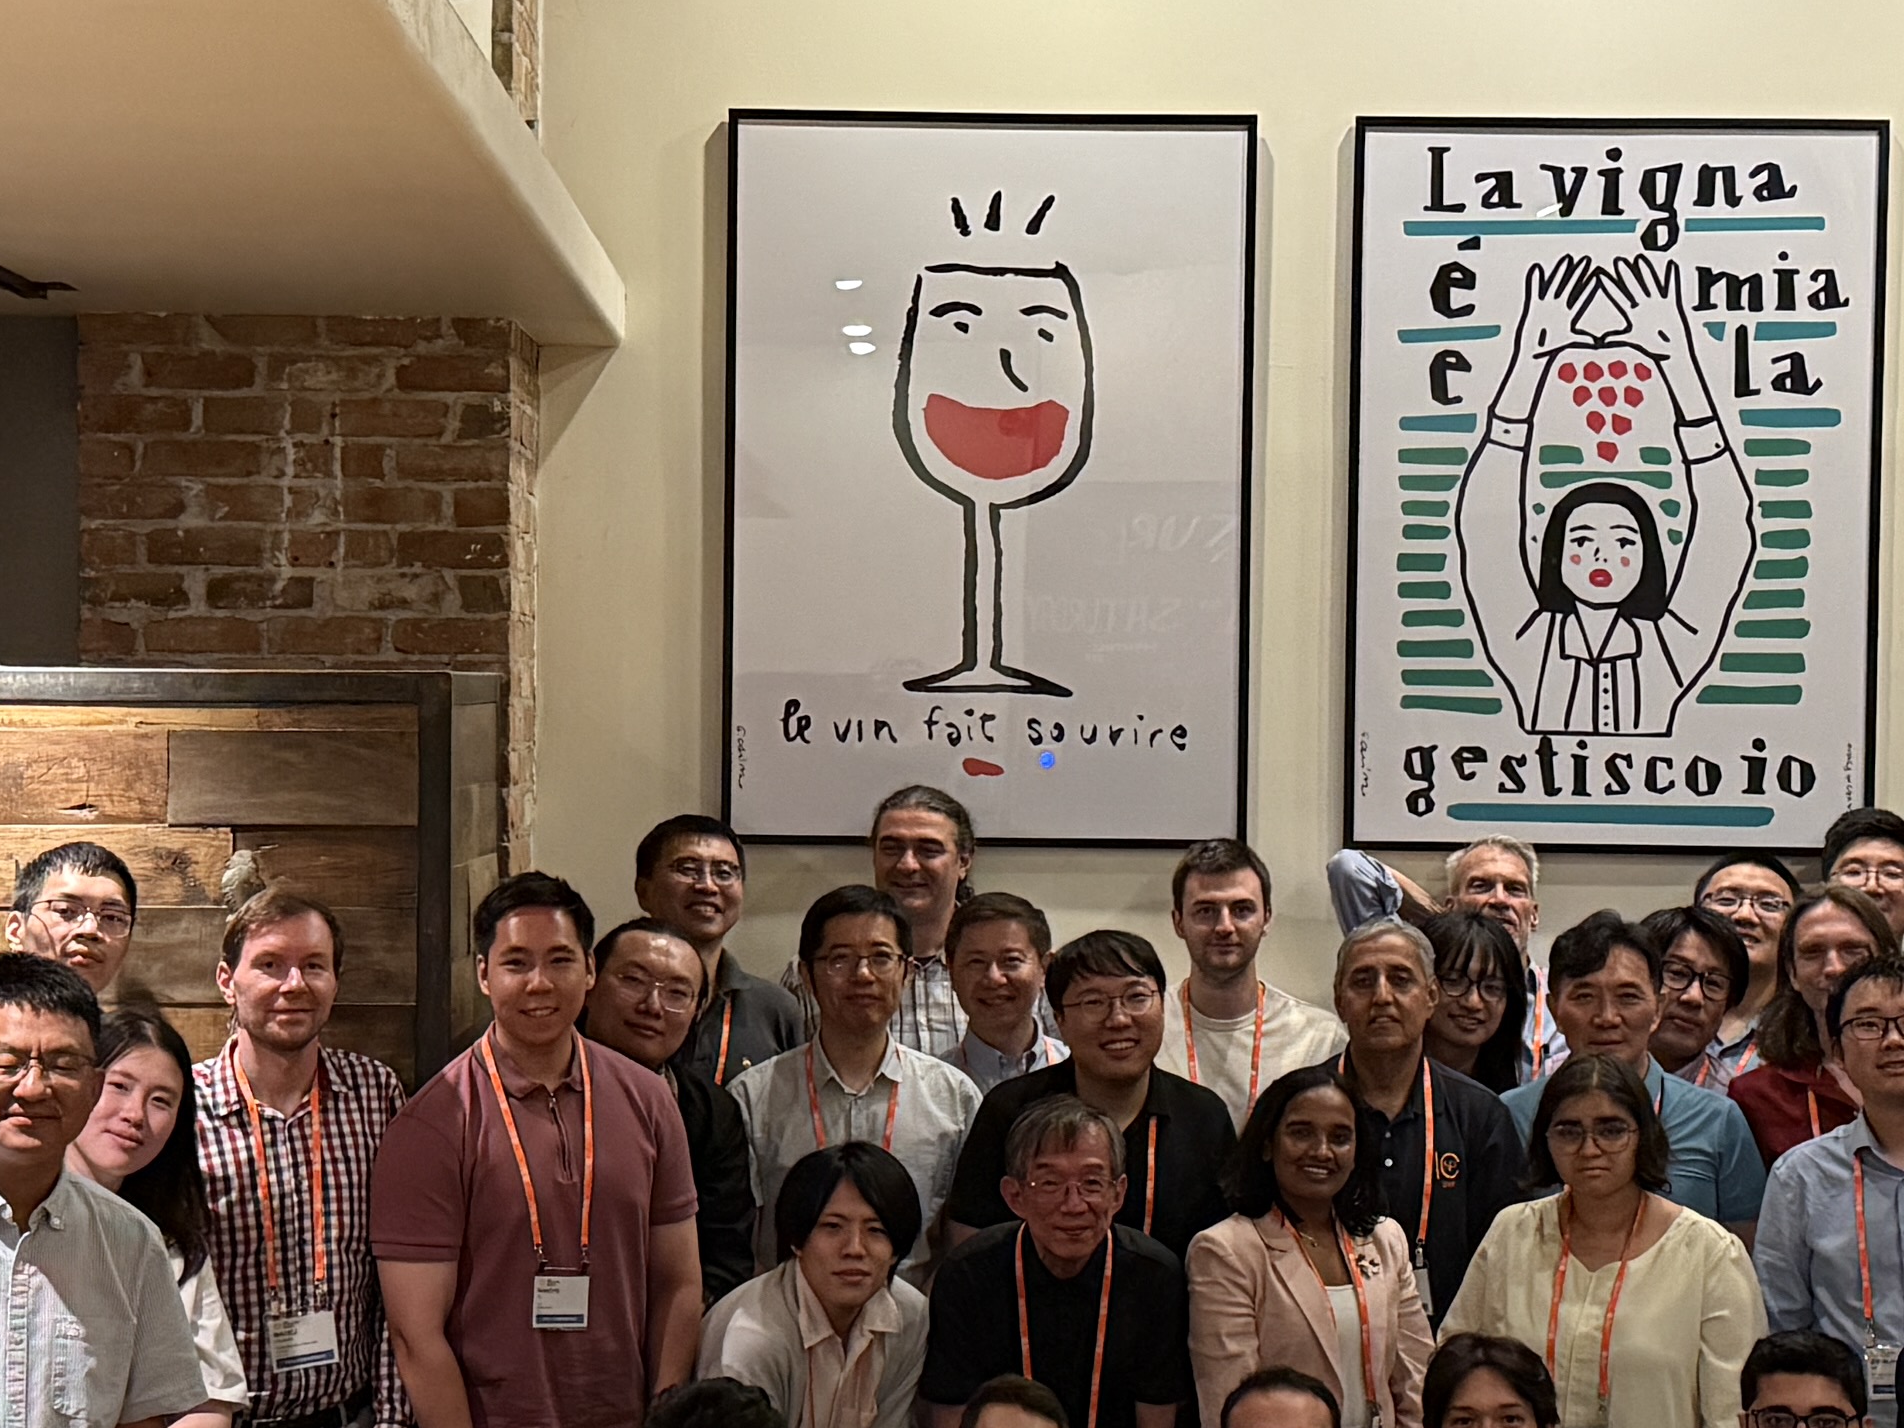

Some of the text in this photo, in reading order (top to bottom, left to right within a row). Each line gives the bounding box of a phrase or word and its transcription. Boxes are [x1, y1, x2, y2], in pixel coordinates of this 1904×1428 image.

[1423, 146, 1798, 254] La vigna
[1691, 251, 1850, 313] mia
[1429, 324, 1823, 406] e la
[779, 698, 812, 745] le
[832, 717, 898, 744] vin
[923, 705, 997, 748] fait
[1403, 734, 1723, 818] gestisco
[1740, 737, 1817, 798] io
